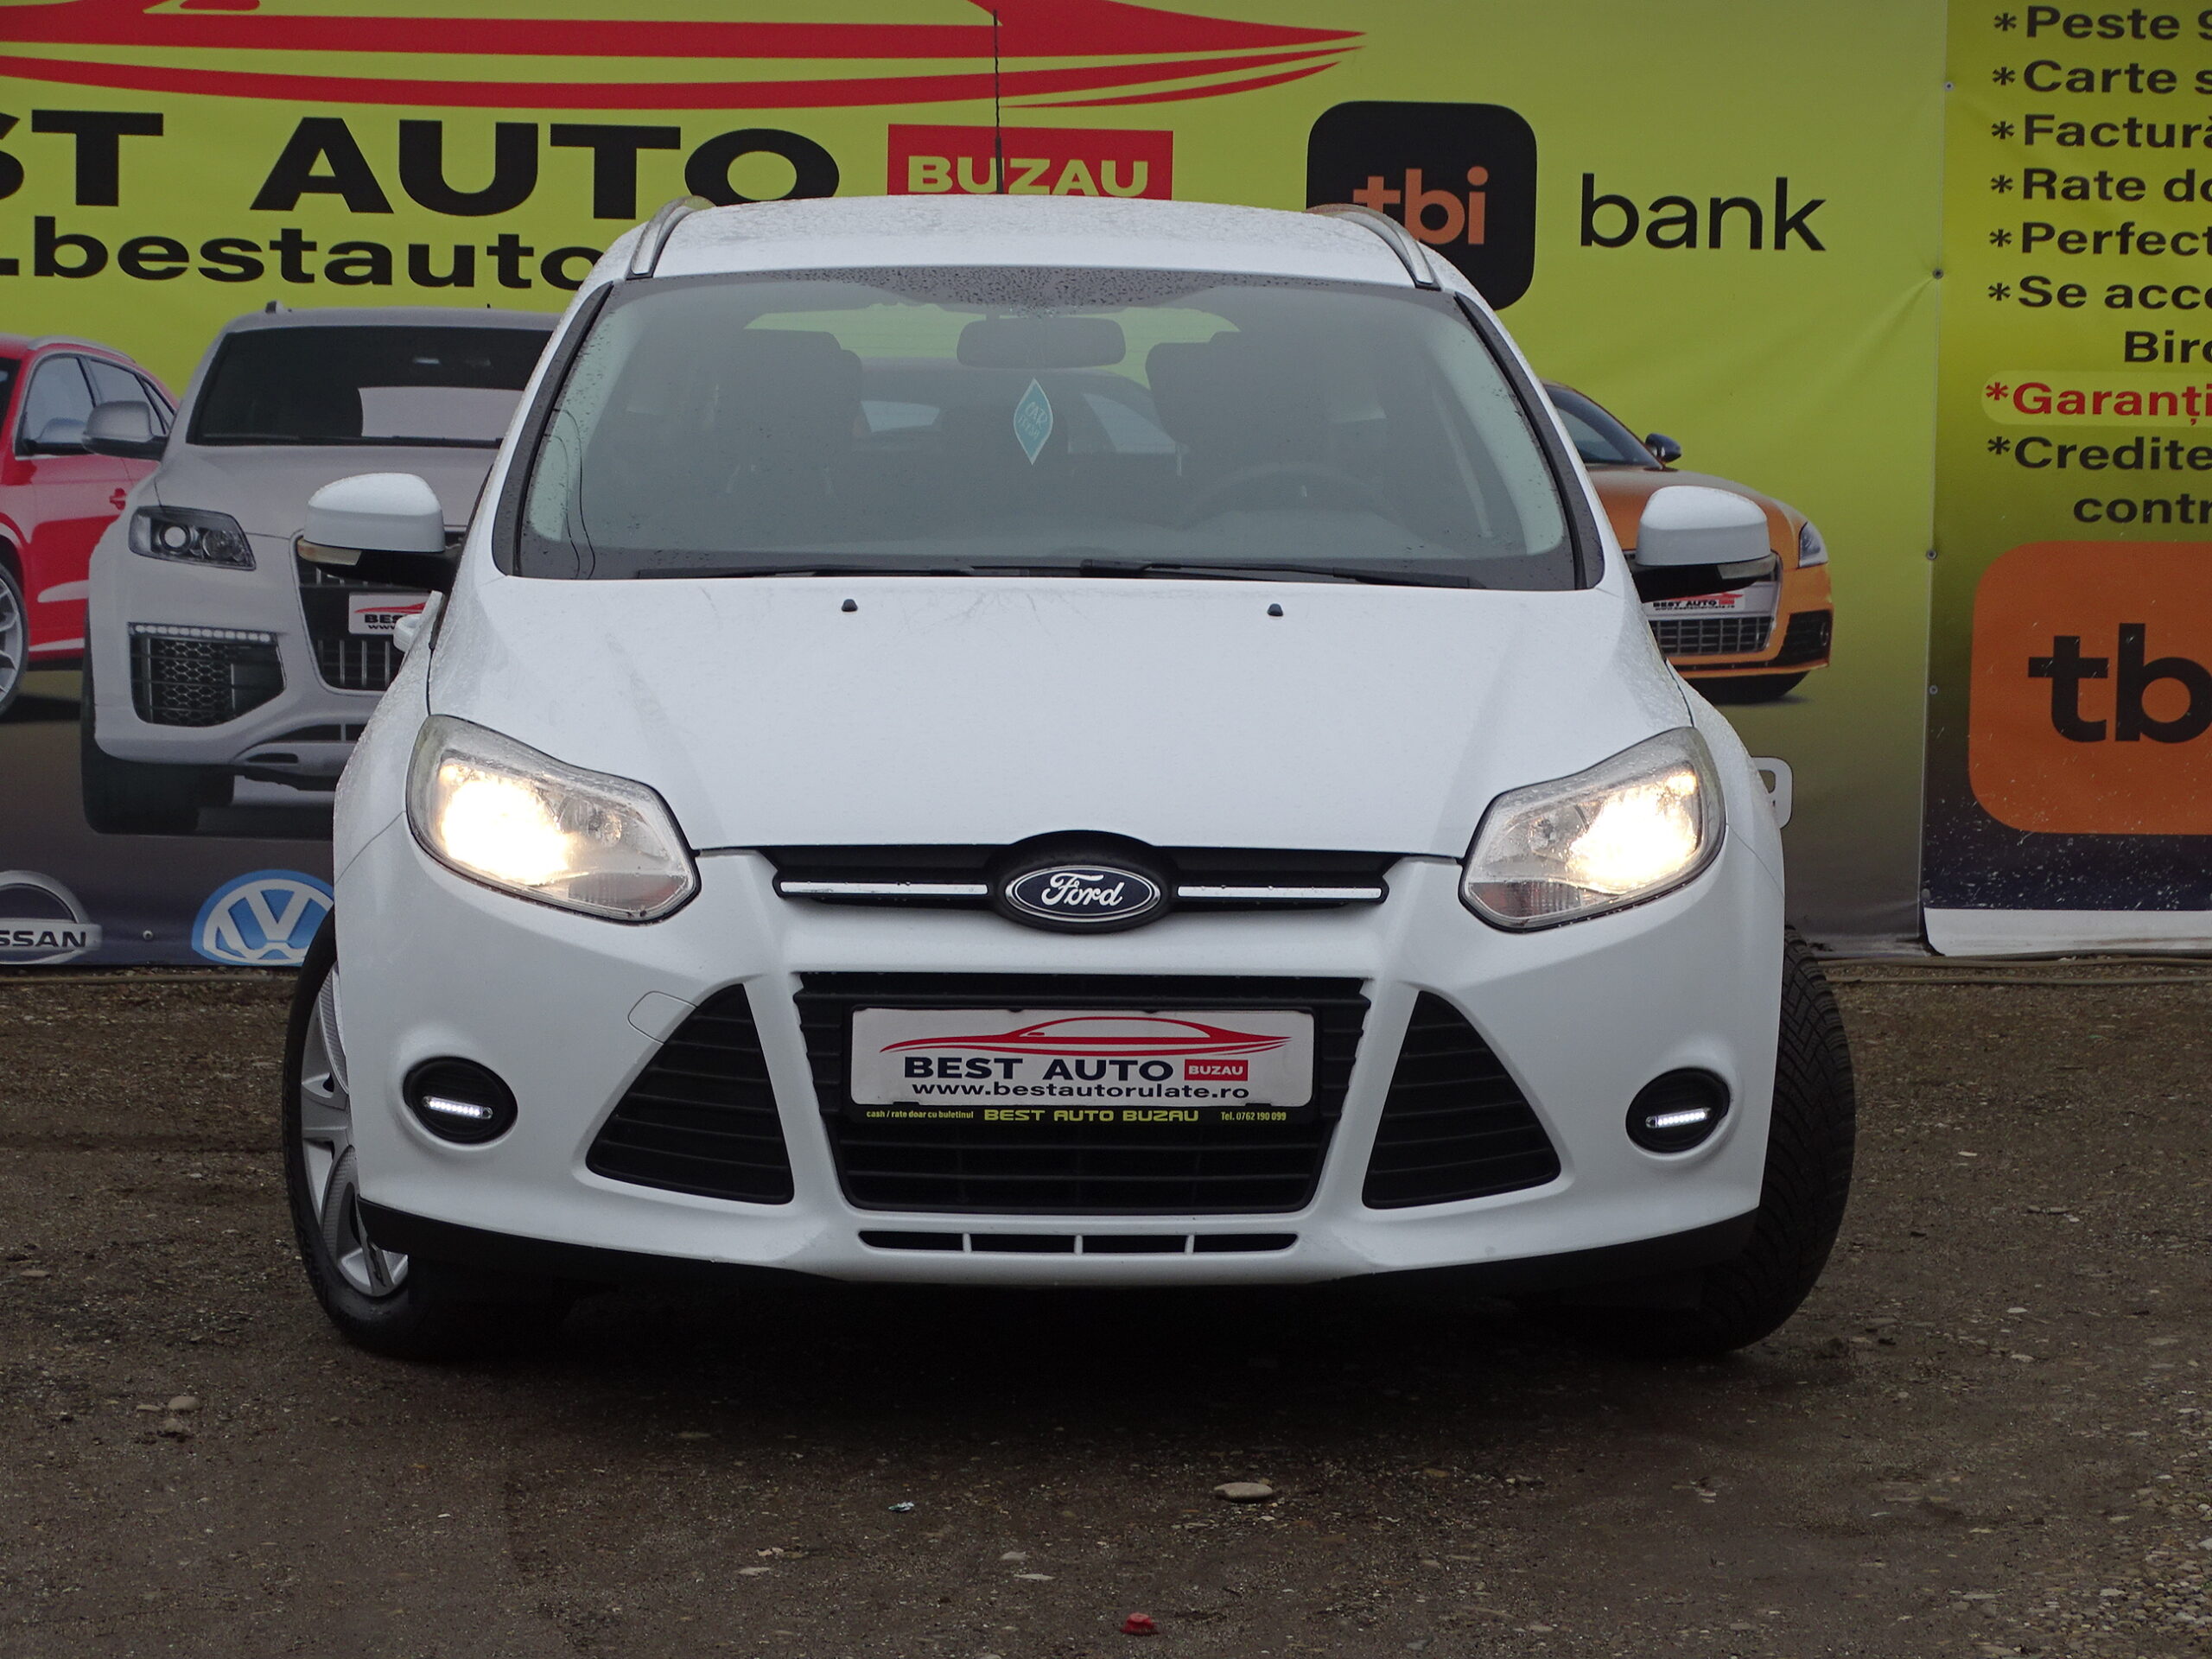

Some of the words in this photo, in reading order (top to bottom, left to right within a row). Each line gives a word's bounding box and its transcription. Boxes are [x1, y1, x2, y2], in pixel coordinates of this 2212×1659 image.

[0, 110, 163, 207] T
[250, 118, 840, 219] AUTO
[908, 156, 1147, 196] BUZAU
[1580, 173, 1827, 251] bank
[2104, 283, 2212, 309] acc
[1041, 873, 1124, 906] Ford
[0, 931, 86, 947] SAN
[904, 1057, 1023, 1079] BEST
[1042, 1059, 1173, 1081] AUTO
[1188, 1065, 1243, 1076] BUZAU
[912, 1081, 1249, 1098] www.bestautorulate.ro
[938, 1110, 974, 1119] buletinul
[984, 1109, 1046, 1122] BEST
[1053, 1109, 1114, 1122] AUTO
[1122, 1109, 1198, 1122] BUZAU
[1221, 1111, 1235, 1121] Tel.
[1236, 1111, 1255, 1121] 0762
[1256, 1111, 1270, 1121] 190
[1271, 1111, 1287, 1121] 099
